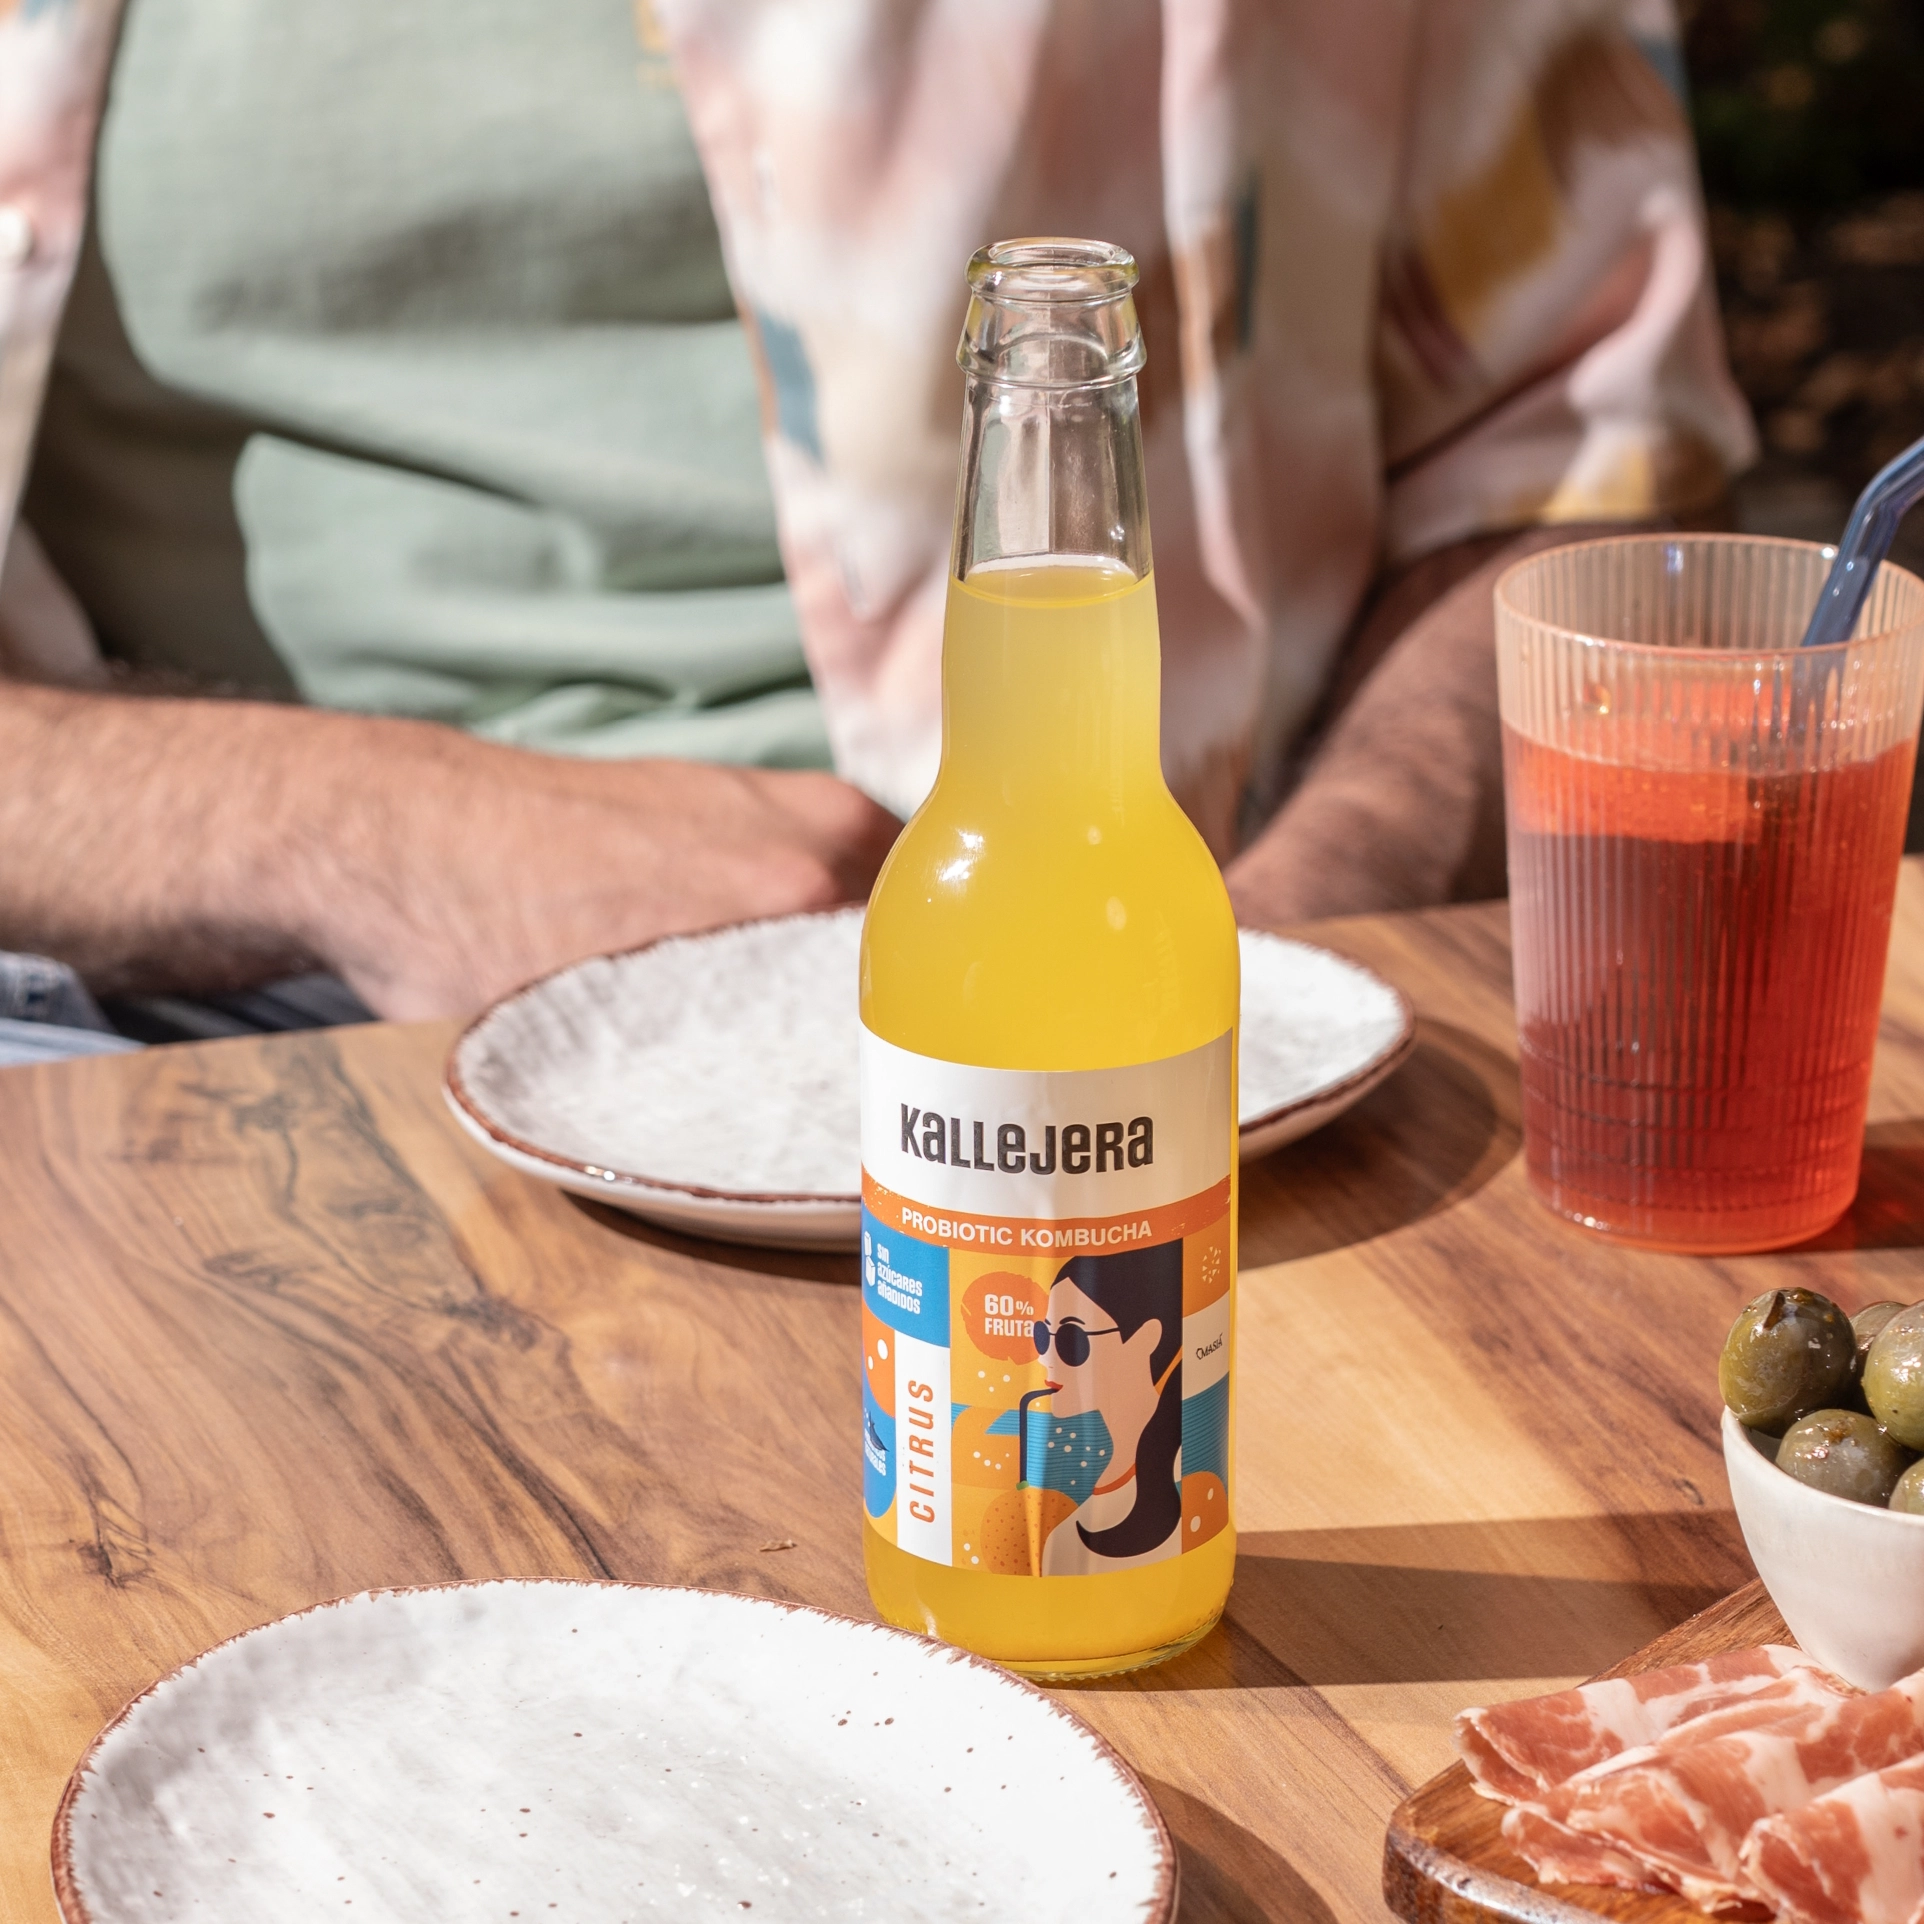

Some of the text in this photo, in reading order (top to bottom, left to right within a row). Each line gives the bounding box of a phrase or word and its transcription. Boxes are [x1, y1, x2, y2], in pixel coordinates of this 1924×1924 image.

[902, 1207, 1153, 1248] PROBIOTIC KOMBUCHA
[984, 1293, 1034, 1317] 60%
[908, 1380, 936, 1523] CITRUS
